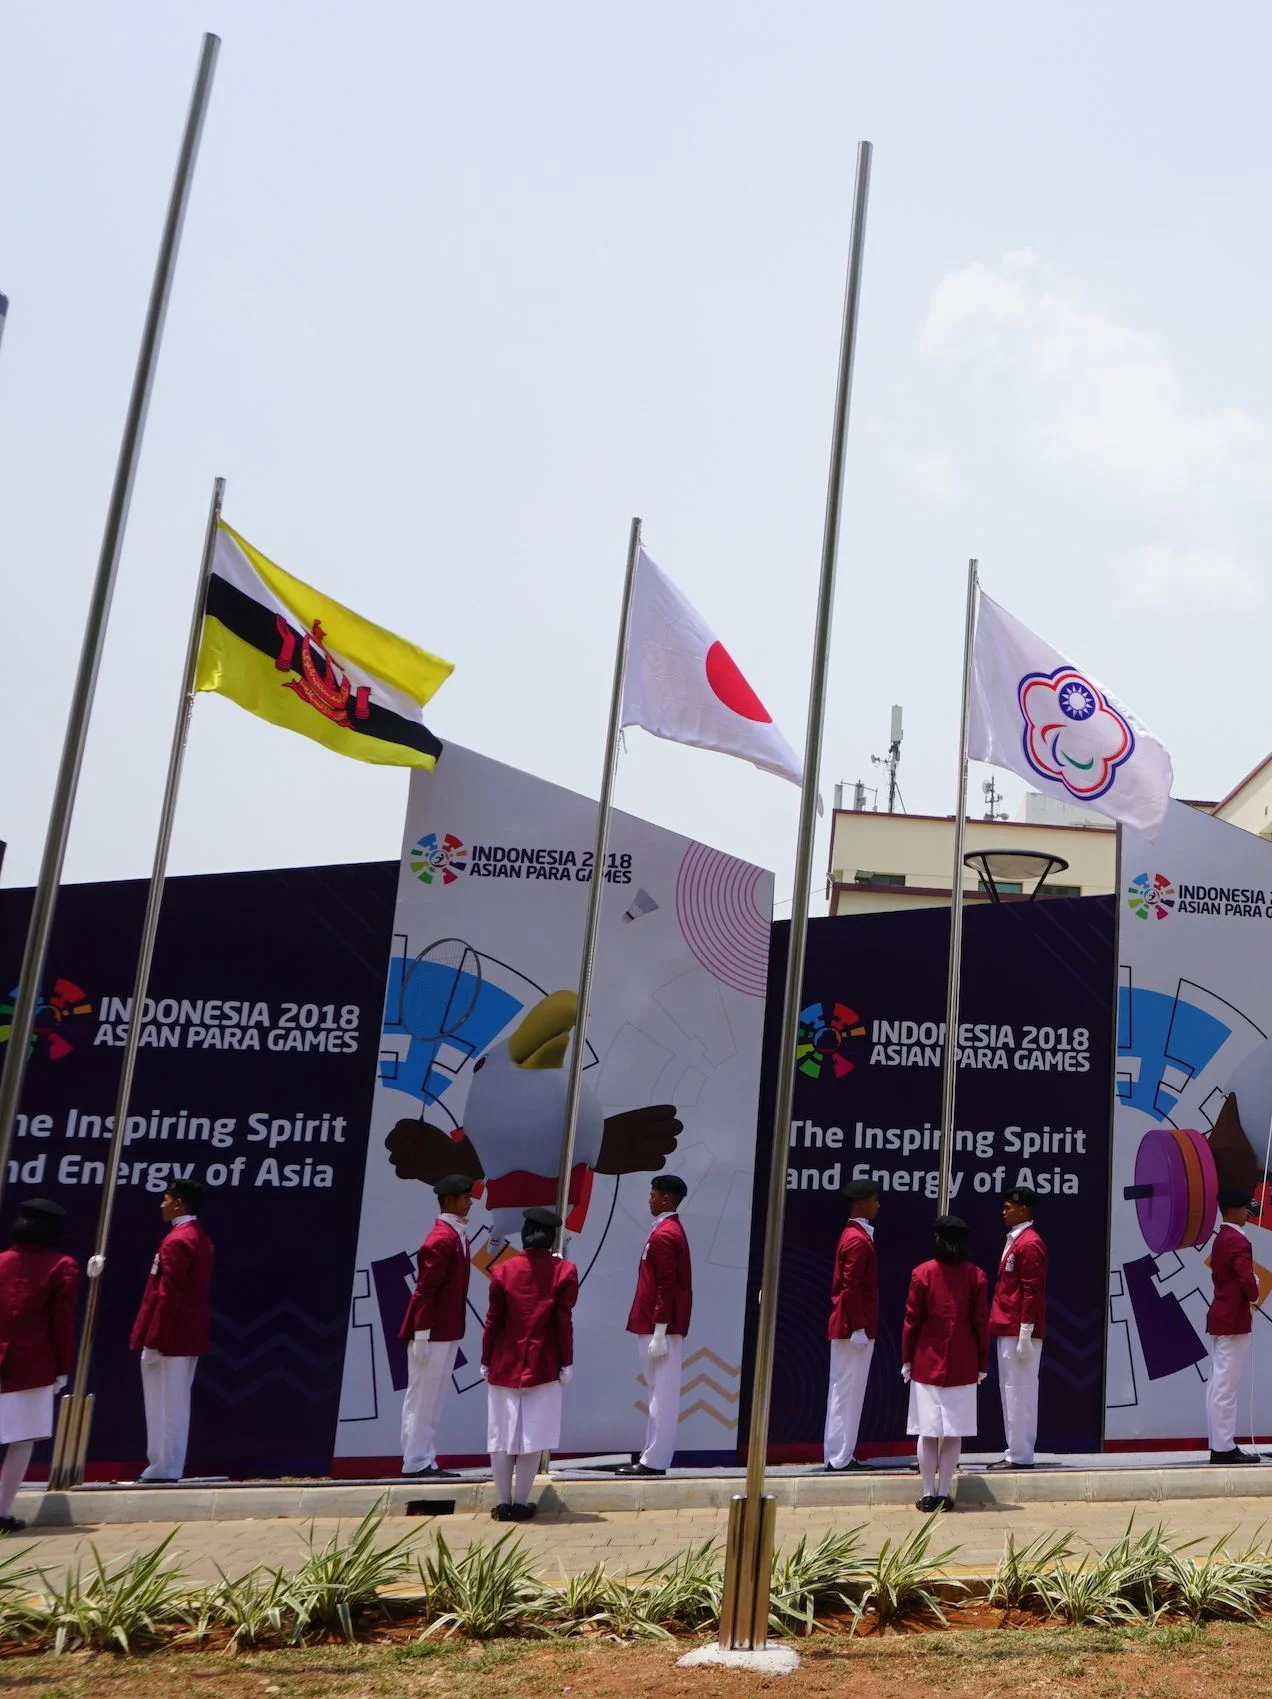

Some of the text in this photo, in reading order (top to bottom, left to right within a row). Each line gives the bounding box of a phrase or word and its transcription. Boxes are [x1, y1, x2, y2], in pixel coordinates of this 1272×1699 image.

[472, 846, 632, 869] INDONESIA 218
[469, 863, 521, 879] ASIAN
[526, 864, 571, 881] PARA
[1178, 884, 1265, 904] INDONESIA
[1178, 900, 1221, 915] ASIAN
[1224, 903, 1263, 918] PARA
[99, 996, 360, 1030] INDONESIA 2018
[93, 1023, 359, 1053] ASAN PARA GAMES
[1021, 1026, 1090, 1050] 2018
[869, 1045, 941, 1067] ASIAN
[1013, 1050, 1090, 1072] GAMES
[65, 1108, 237, 1148] Inspiring
[247, 1112, 347, 1148] Spirit
[789, 1119, 1087, 1159] The Inspirng Spirit
[8, 1153, 47, 1184] nd
[206, 1157, 246, 1187] of
[254, 1157, 334, 1188] Asia
[786, 1162, 1079, 1199] and Energy of Asia
